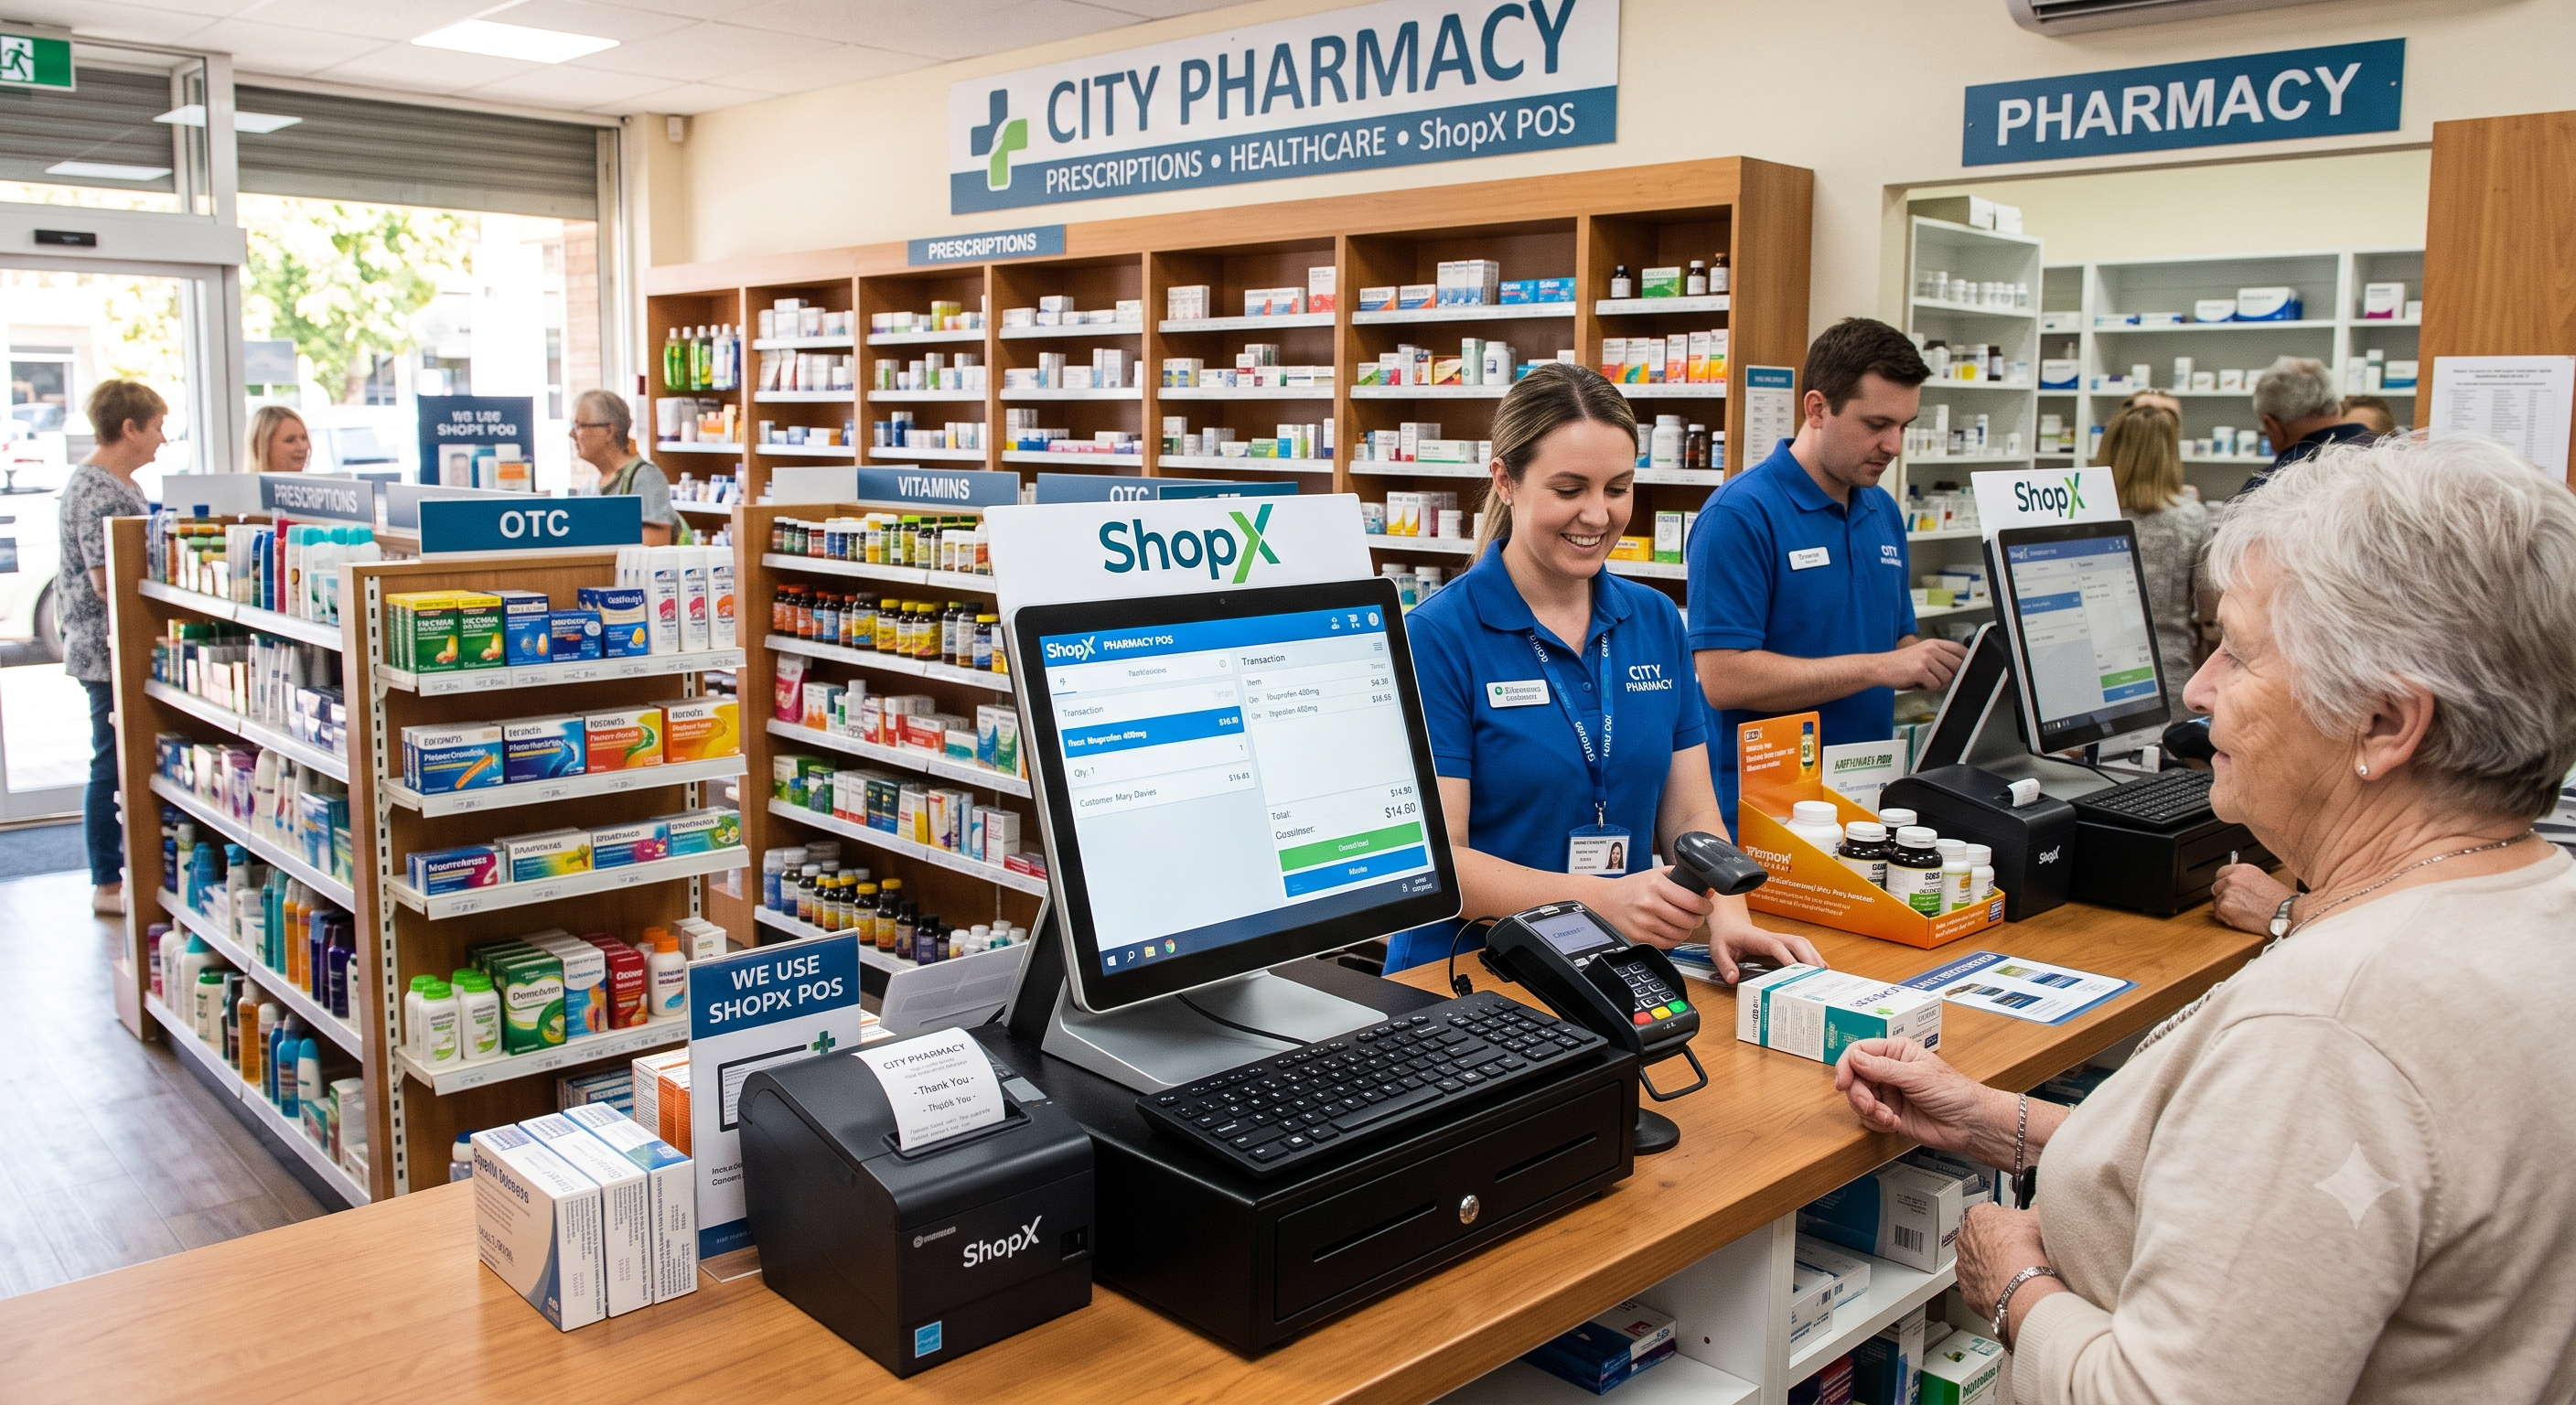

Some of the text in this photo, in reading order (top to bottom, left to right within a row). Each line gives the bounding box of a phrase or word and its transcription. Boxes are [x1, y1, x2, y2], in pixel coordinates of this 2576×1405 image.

[1047, 0, 1577, 144] CITY PHARMACY
[1997, 62, 2362, 146] PHARMACY
[1046, 102, 1575, 194] PRESCRIPTIONS HEALTHCARE ShopX POS
[928, 232, 1037, 260] PRESCRIPTIONS
[274, 483, 359, 514] PRESCRIPTIONS
[897, 476, 971, 500] VITAMINS
[1110, 486, 1149, 502] OTC
[2014, 472, 2086, 519] ShopX
[499, 509, 570, 539] OTC
[1099, 503, 1282, 585] ShopX
[1881, 545, 1897, 557] CITY
[1046, 636, 1174, 660] ShopX PHARMACY POS
[1241, 654, 1286, 666] Transaction
[1247, 679, 1262, 687] Item
[1628, 664, 1662, 680] CITY
[1626, 679, 1673, 692] PHARMACY
[1063, 706, 1104, 718] Transaction
[1115, 793, 1132, 802] Mary
[1133, 788, 1157, 799] Davies
[1271, 810, 1292, 820] Total:
[731, 954, 820, 990] WE USE
[709, 977, 843, 1024] SHOPX POS
[883, 1057, 907, 1070] CITY
[918, 1077, 970, 1096] Thank You
[962, 1215, 1043, 1268] ShopX
